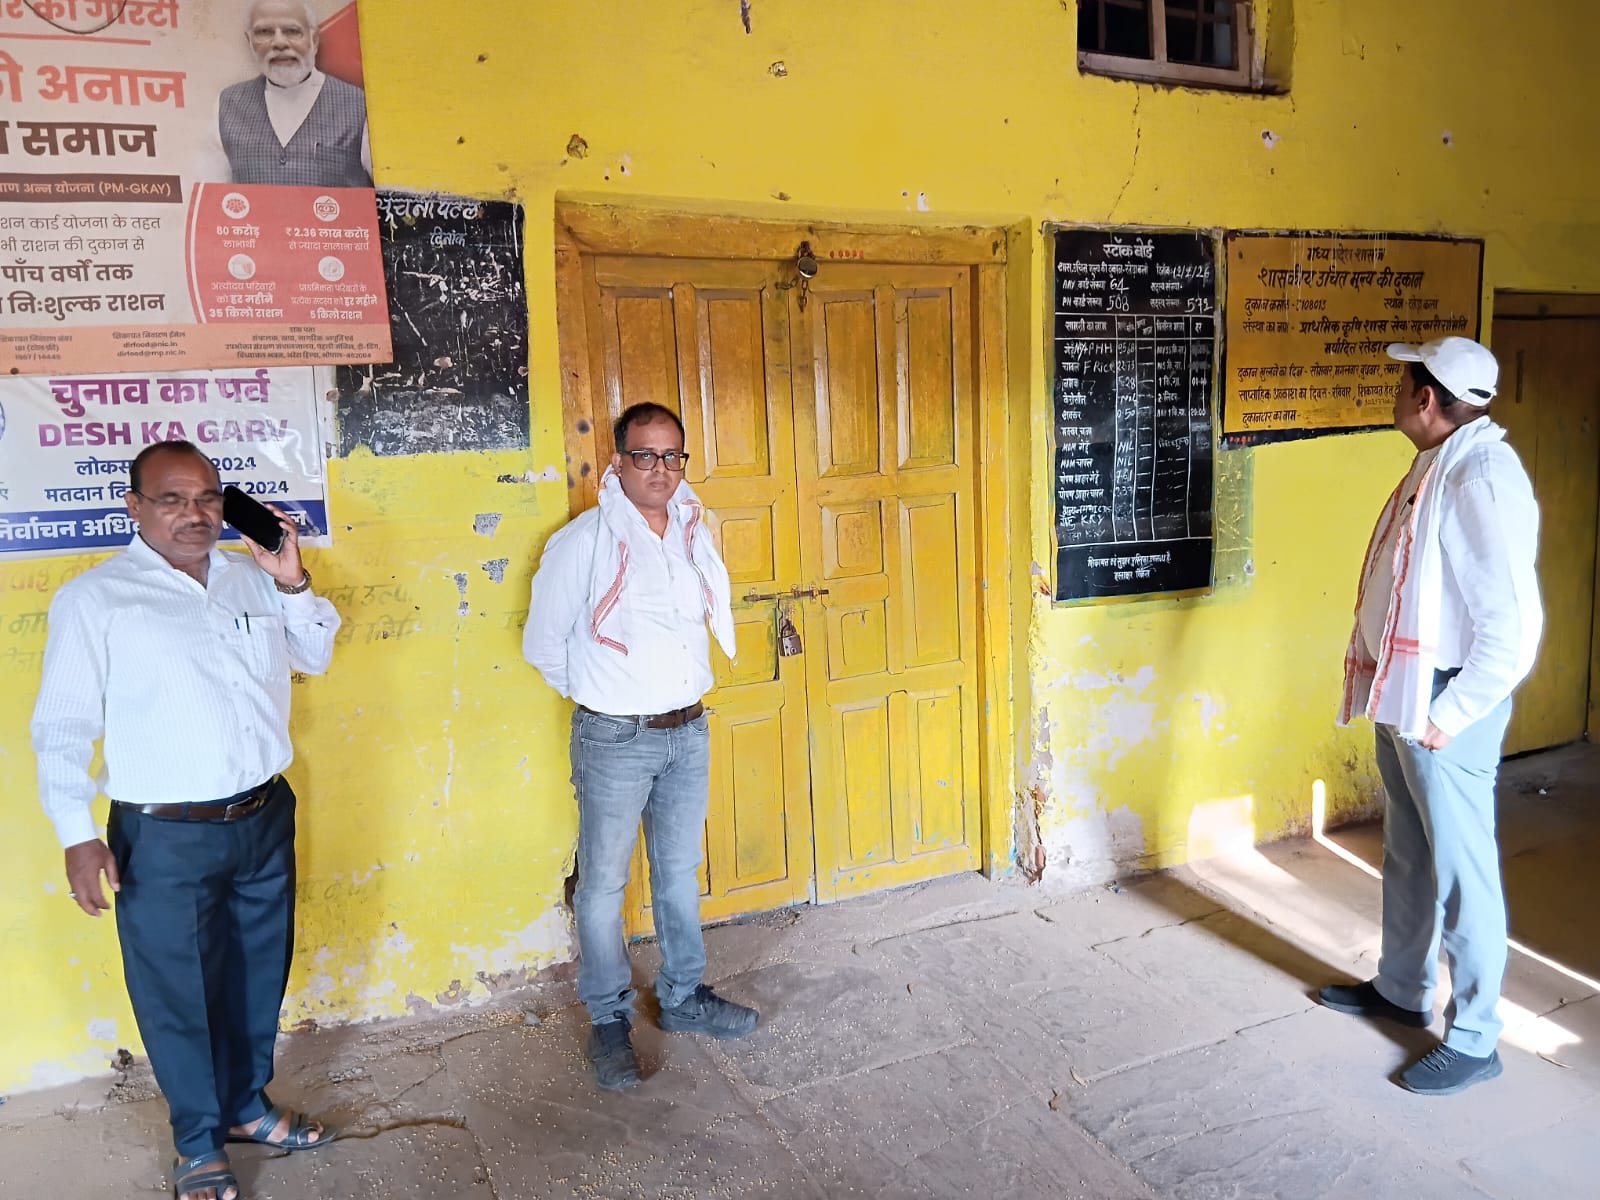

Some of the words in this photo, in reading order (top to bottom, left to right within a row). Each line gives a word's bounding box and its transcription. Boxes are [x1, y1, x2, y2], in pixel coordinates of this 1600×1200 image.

[37, 65, 187, 108] अनाज
[16, 121, 157, 157] समाज
[24, 182, 52, 194] अन्न
[55, 180, 95, 194] योजना
[99, 182, 171, 197] (PM-GKAY)
[30, 213, 60, 231] कार्ड
[62, 214, 108, 230] योजना
[112, 213, 127, 230] के
[131, 217, 161, 231] तहत
[21, 239, 60, 252] राशन
[64, 235, 84, 252] की
[87, 237, 129, 255] दुकान
[132, 236, 145, 251] से
[1103, 236, 1133, 258] स्टॉक
[1134, 237, 1155, 259] बोर्ड
[1, 257, 44, 283] पाँच
[49, 258, 93, 282] वर्षों
[93, 264, 134, 282] तक
[1257, 263, 1316, 289] शासकीय
[1315, 265, 1350, 290] उचित
[1349, 271, 1377, 293] मूल्य
[1376, 266, 1394, 289] की
[1393, 272, 1424, 297] दुकान
[1110, 277, 1130, 294] 64
[7, 290, 101, 321] निःशुल्क
[106, 293, 166, 311] राशन
[1106, 294, 1130, 312] 508
[1266, 320, 1276, 333] का
[1299, 315, 1340, 335] प्राथमिक
[49, 378, 150, 418] चुनाव
[156, 378, 209, 404] का
[215, 368, 271, 403] पर्व
[38, 421, 132, 447] DESH
[140, 421, 187, 445] KA
[196, 419, 289, 444] GARV
[74, 456, 134, 475] लोकस
[210, 457, 256, 471] 2024
[44, 486, 104, 502] मतदान
[245, 480, 289, 495] 2024
